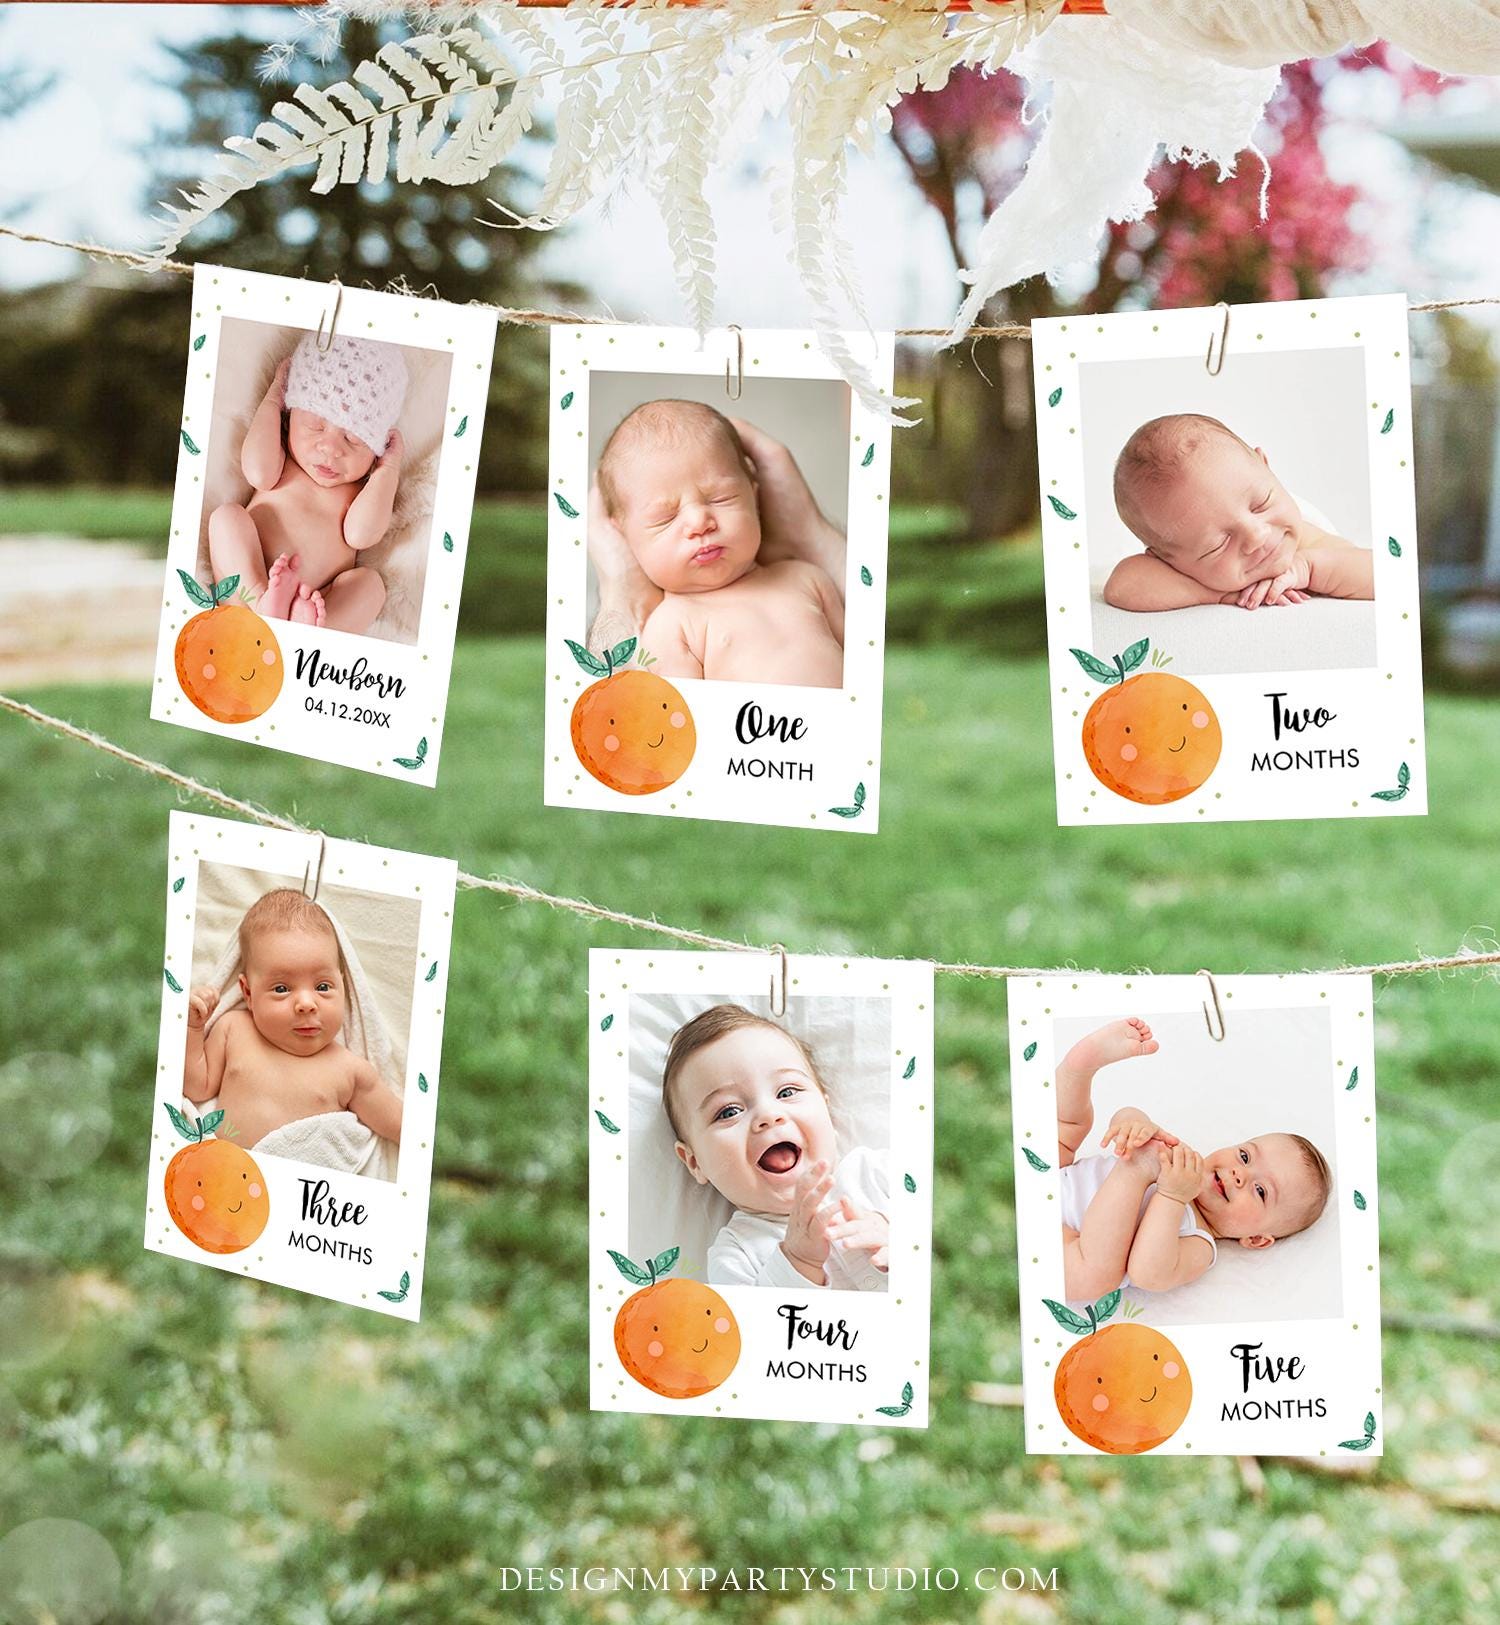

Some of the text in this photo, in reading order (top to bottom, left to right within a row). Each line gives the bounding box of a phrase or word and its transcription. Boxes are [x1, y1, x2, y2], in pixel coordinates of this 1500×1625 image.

[294, 648, 406, 699] Newborn
[304, 696, 391, 729] 04.12.20XX
[734, 700, 808, 745] One
[1263, 692, 1337, 741] Two
[727, 757, 814, 782] MONTH
[1251, 748, 1360, 772] MONTHS
[297, 1178, 369, 1228] Three
[288, 1230, 373, 1266] MONTHS
[776, 1304, 859, 1351] Four
[766, 1360, 867, 1383] MONTHS
[1230, 1342, 1306, 1394] Five
[1221, 1397, 1327, 1422] MONTHS
